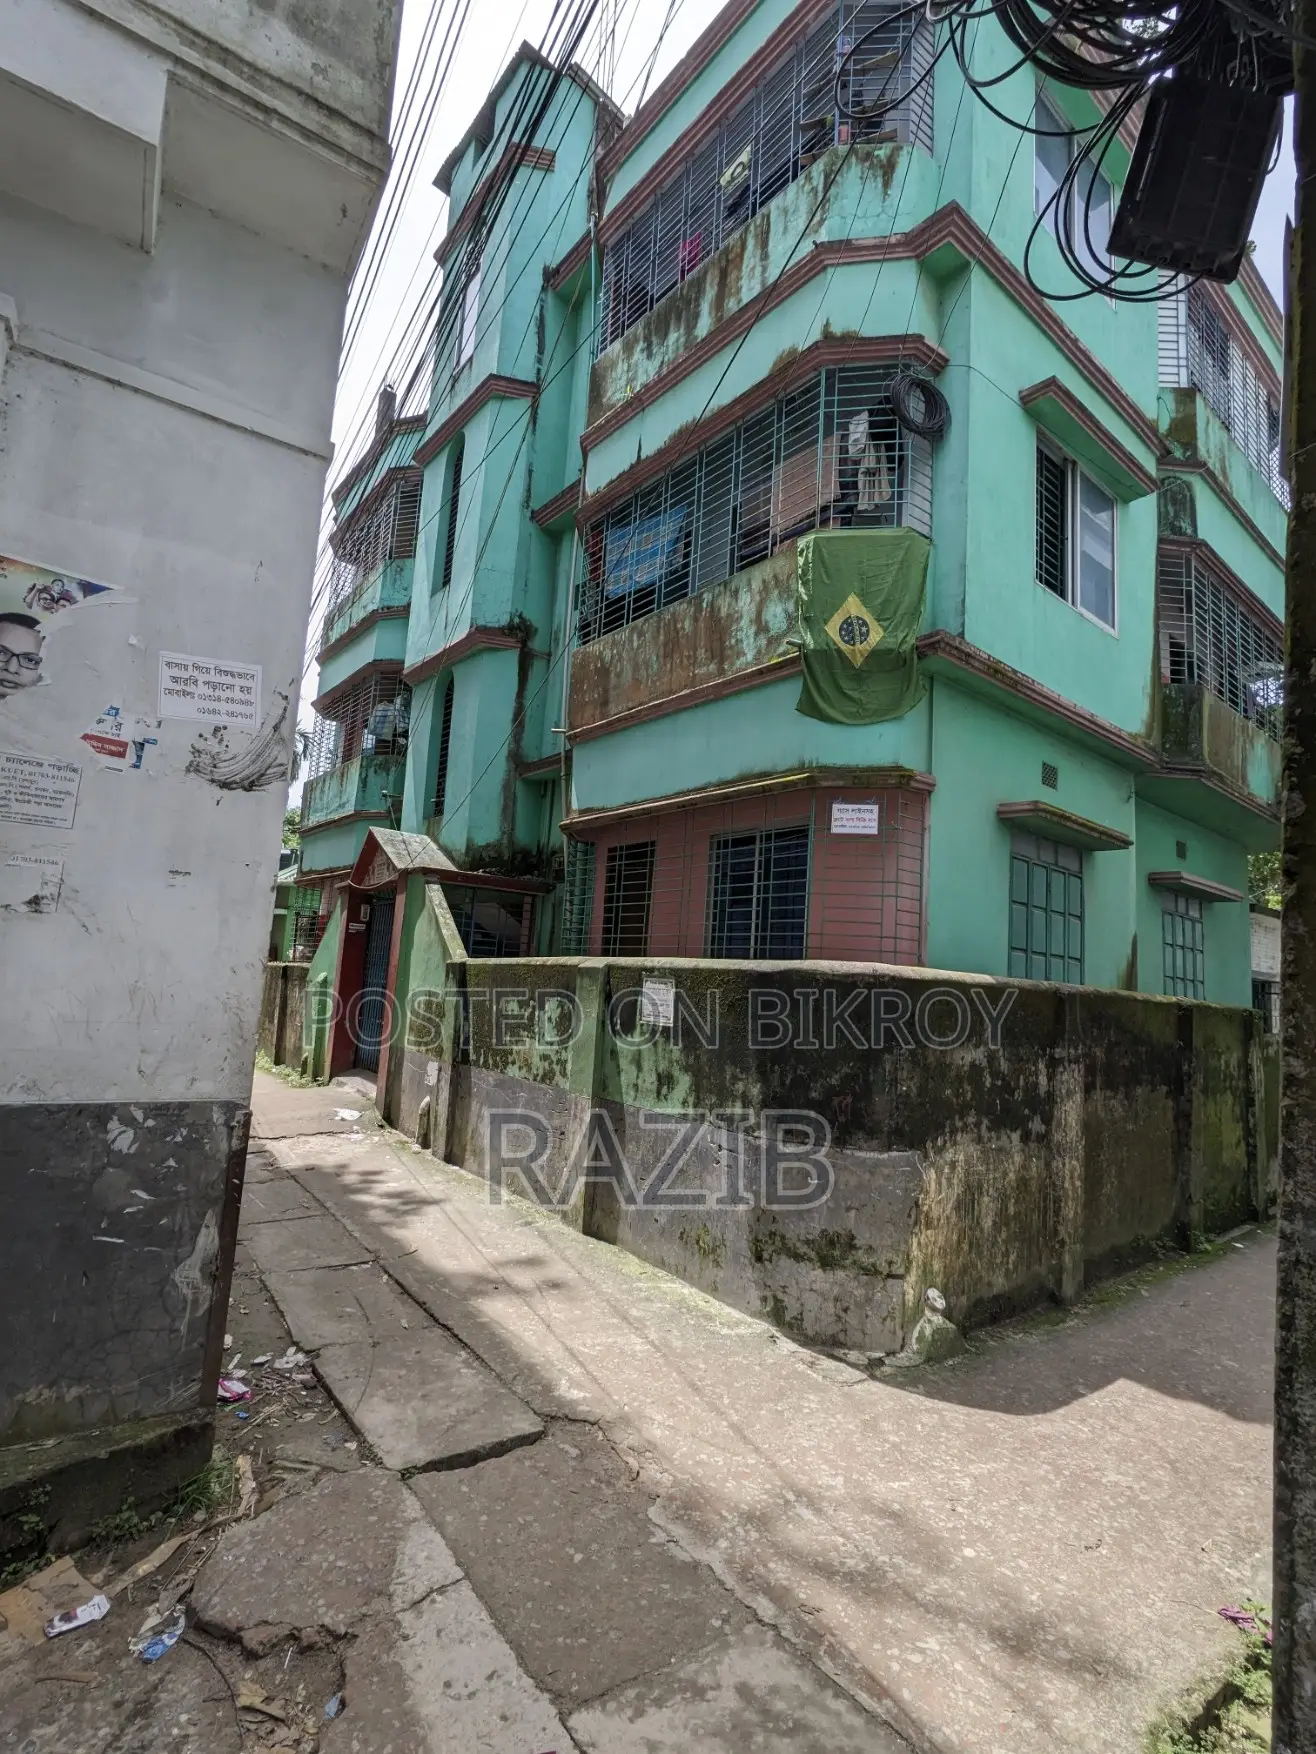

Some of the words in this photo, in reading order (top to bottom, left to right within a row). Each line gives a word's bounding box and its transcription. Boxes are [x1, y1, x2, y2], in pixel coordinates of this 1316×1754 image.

[164, 660, 189, 672] বাসায়
[169, 675, 198, 688] আরবি
[202, 680, 236, 693] পড়ানো
[239, 685, 252, 696] হয়
